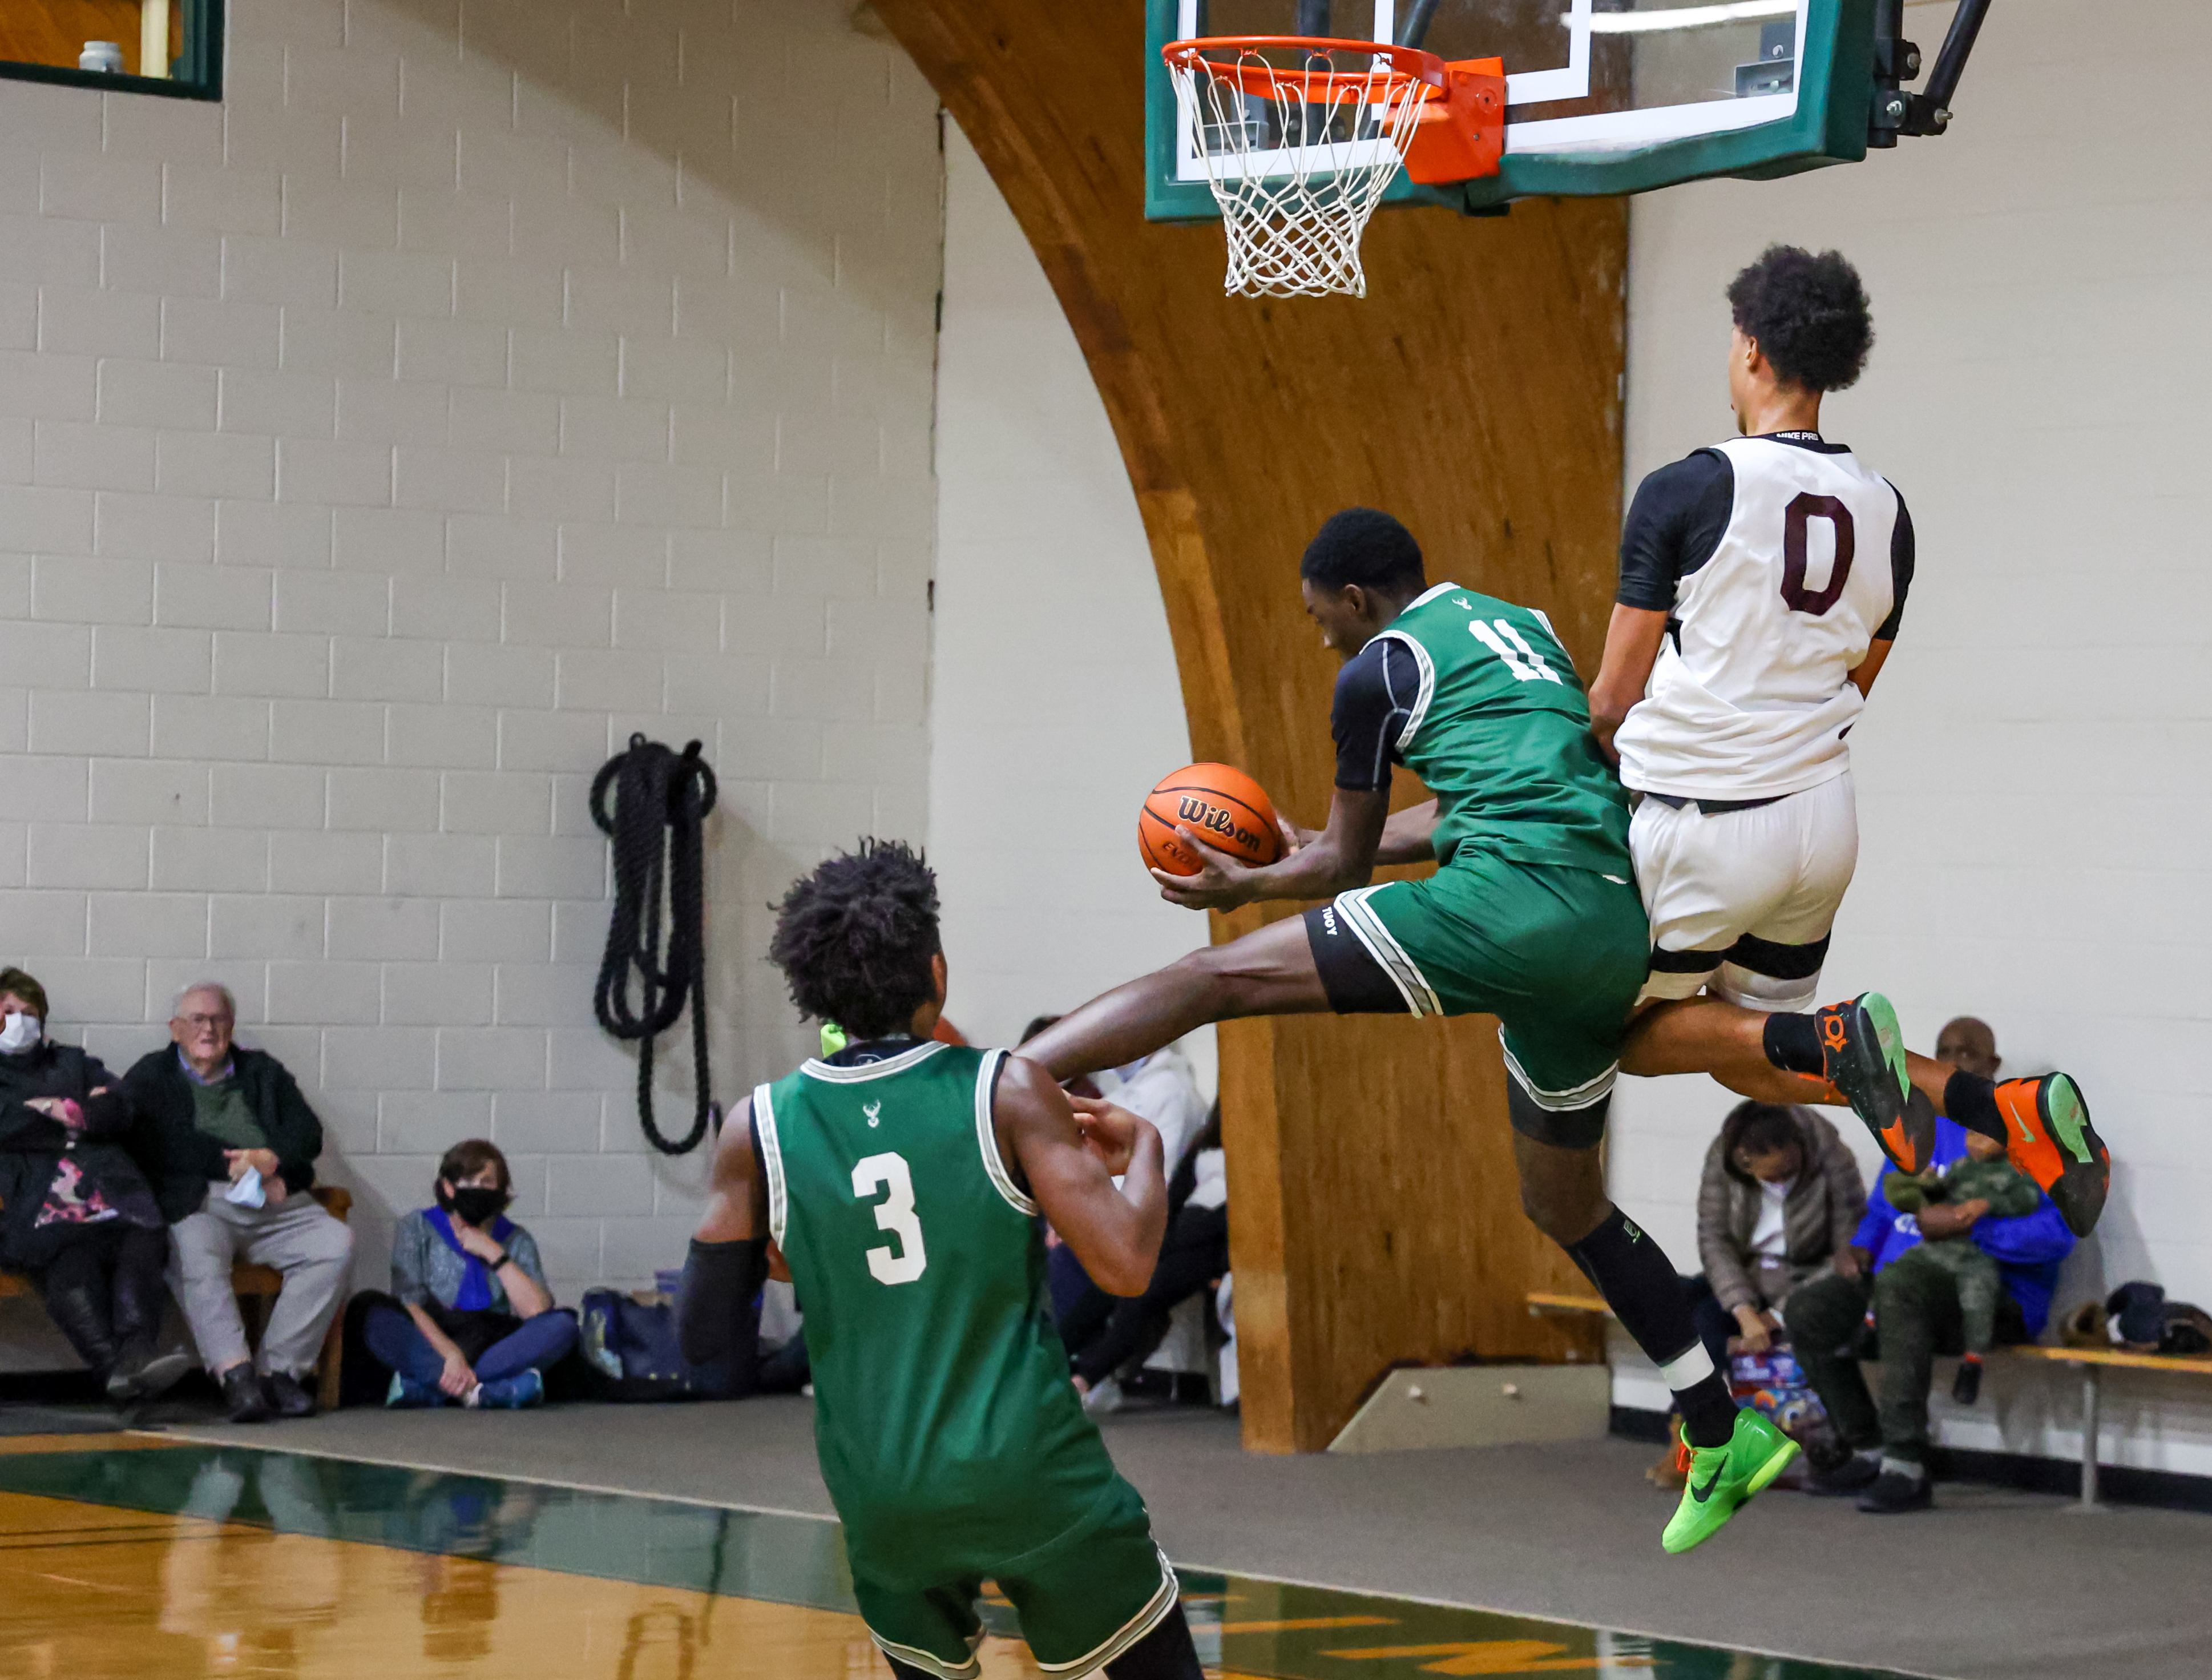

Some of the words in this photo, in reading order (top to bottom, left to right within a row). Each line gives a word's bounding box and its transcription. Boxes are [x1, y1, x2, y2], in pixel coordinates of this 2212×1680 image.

[1776, 432, 1801, 440] NIKE
[1468, 618, 1564, 686] 11
[1177, 795, 1261, 853] Wilson
[851, 1151, 927, 1286] 3
